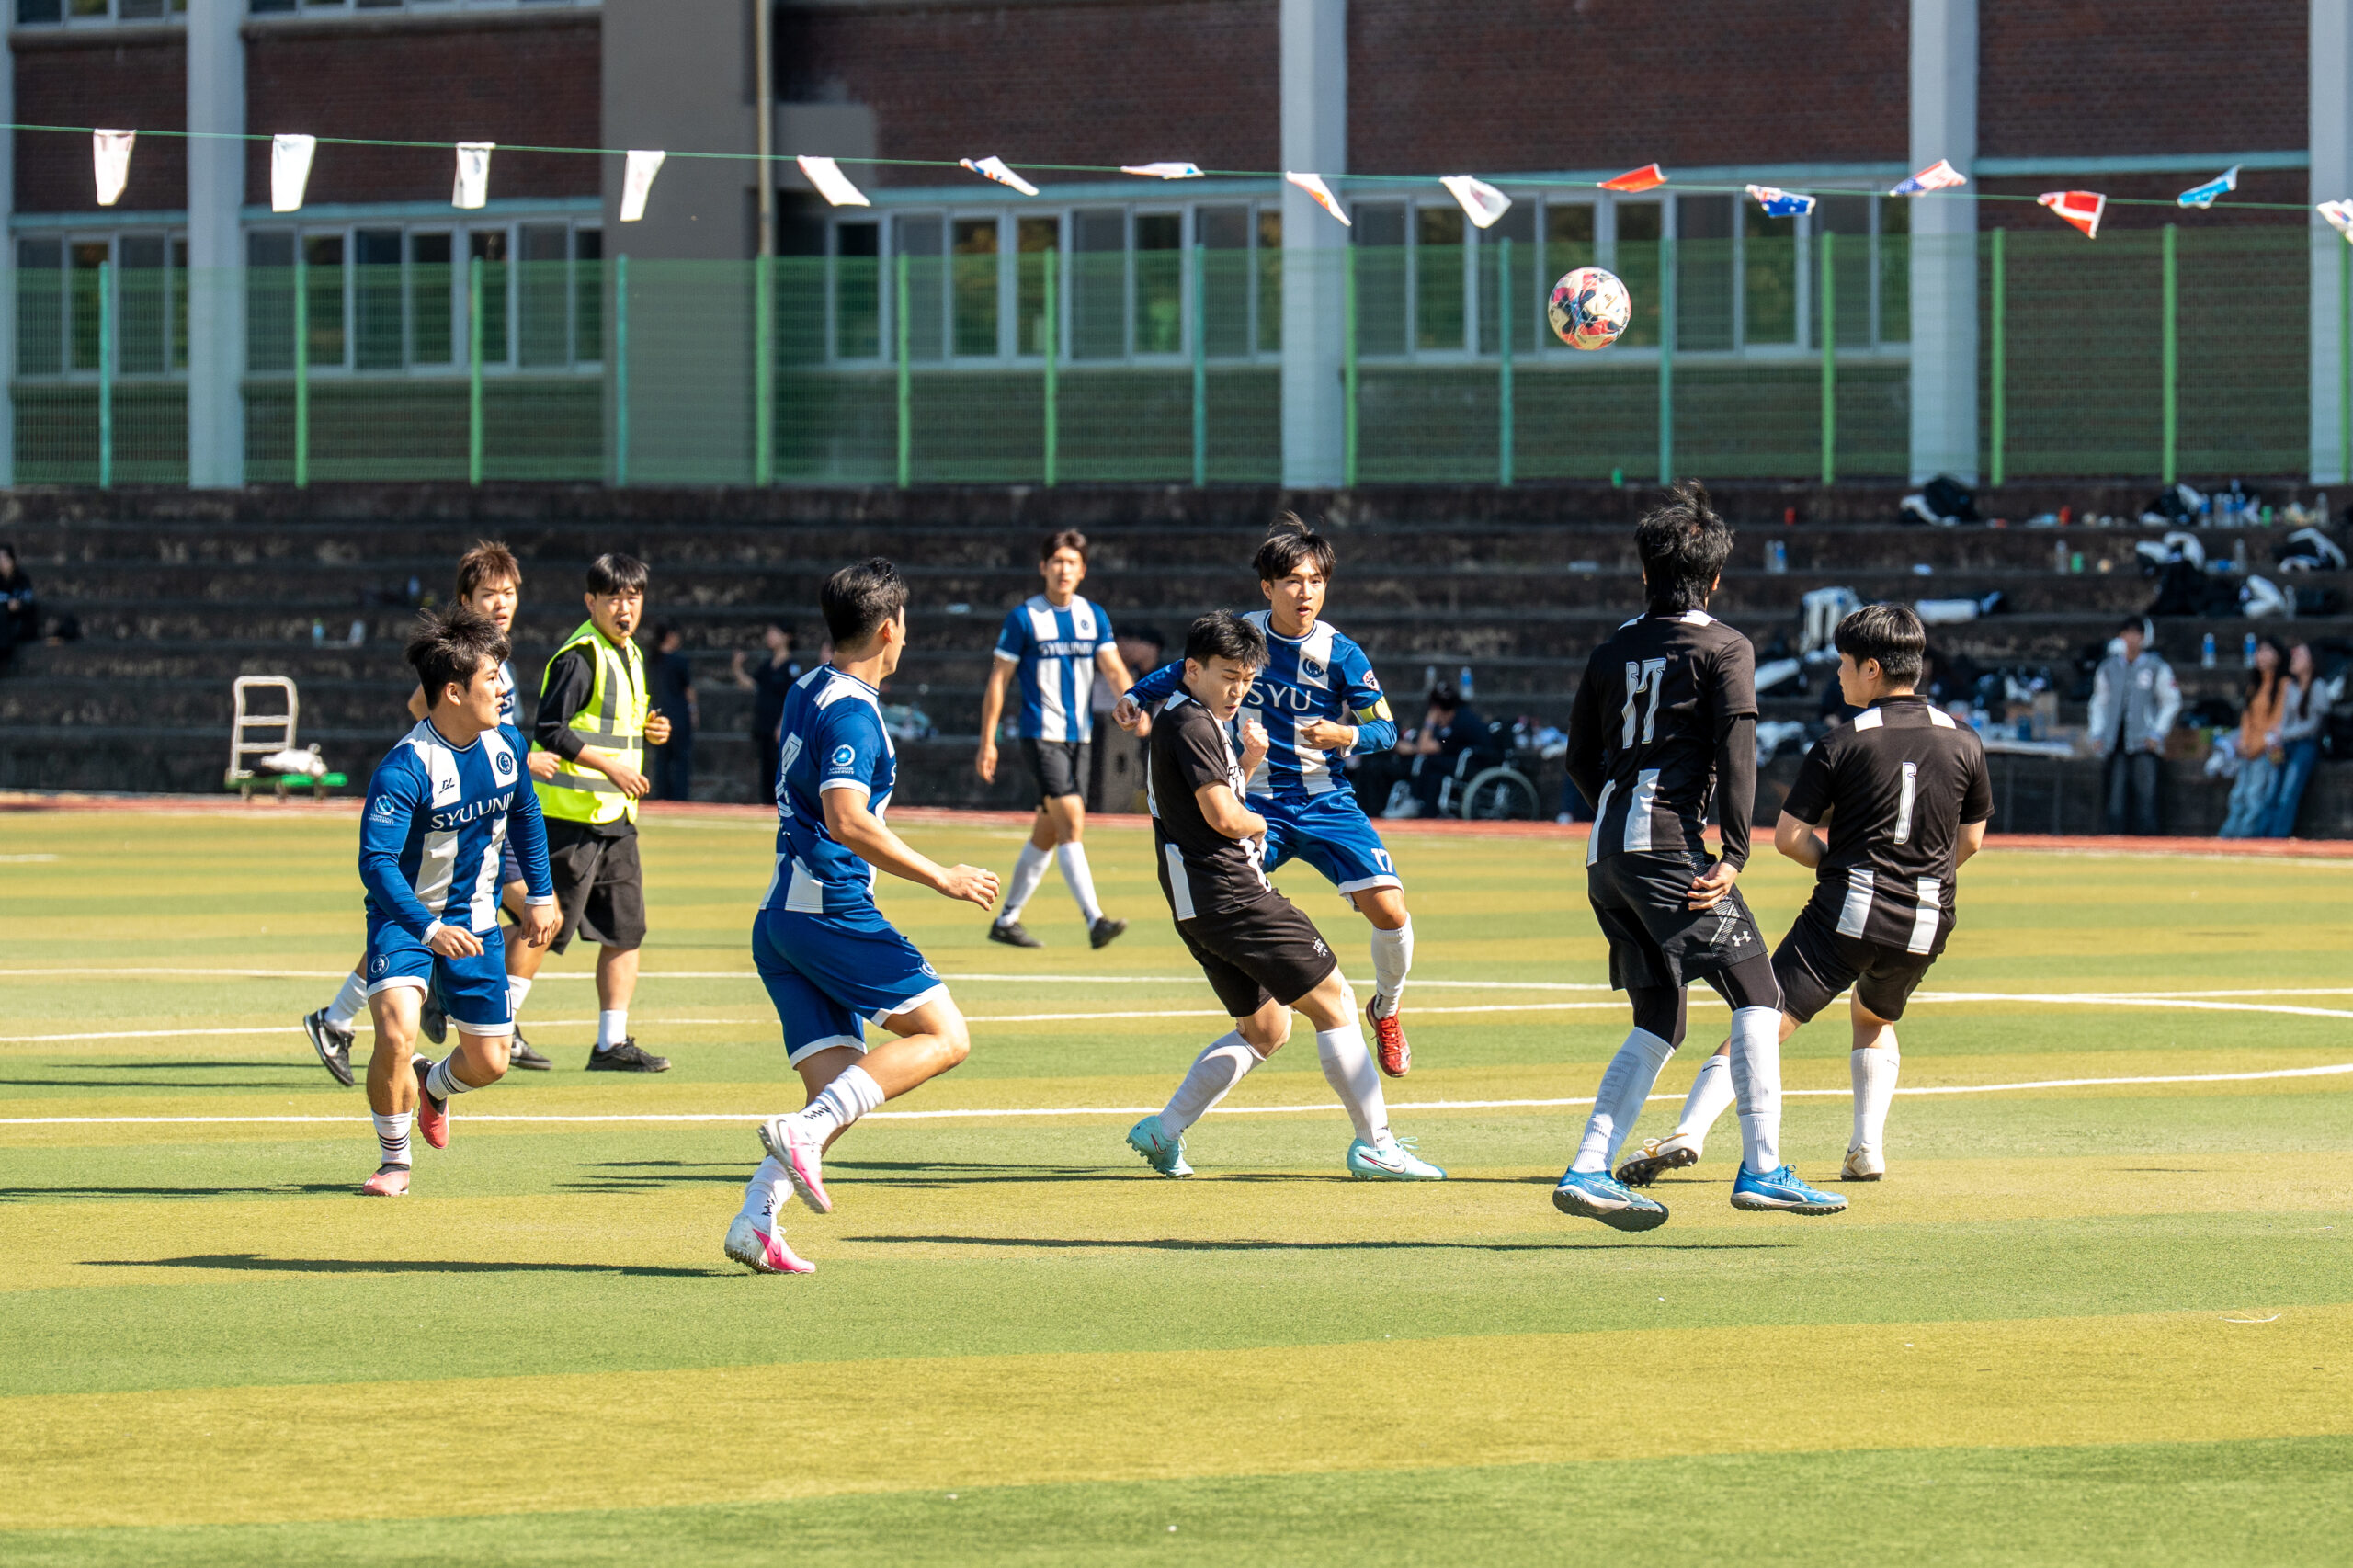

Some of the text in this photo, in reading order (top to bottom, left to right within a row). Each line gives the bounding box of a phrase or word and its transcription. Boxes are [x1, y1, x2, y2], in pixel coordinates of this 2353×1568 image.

[1247, 681, 1312, 711] SYU
[1621, 657, 1666, 749] 17
[1893, 762, 1917, 844] 1
[1370, 847, 1393, 873] 17
